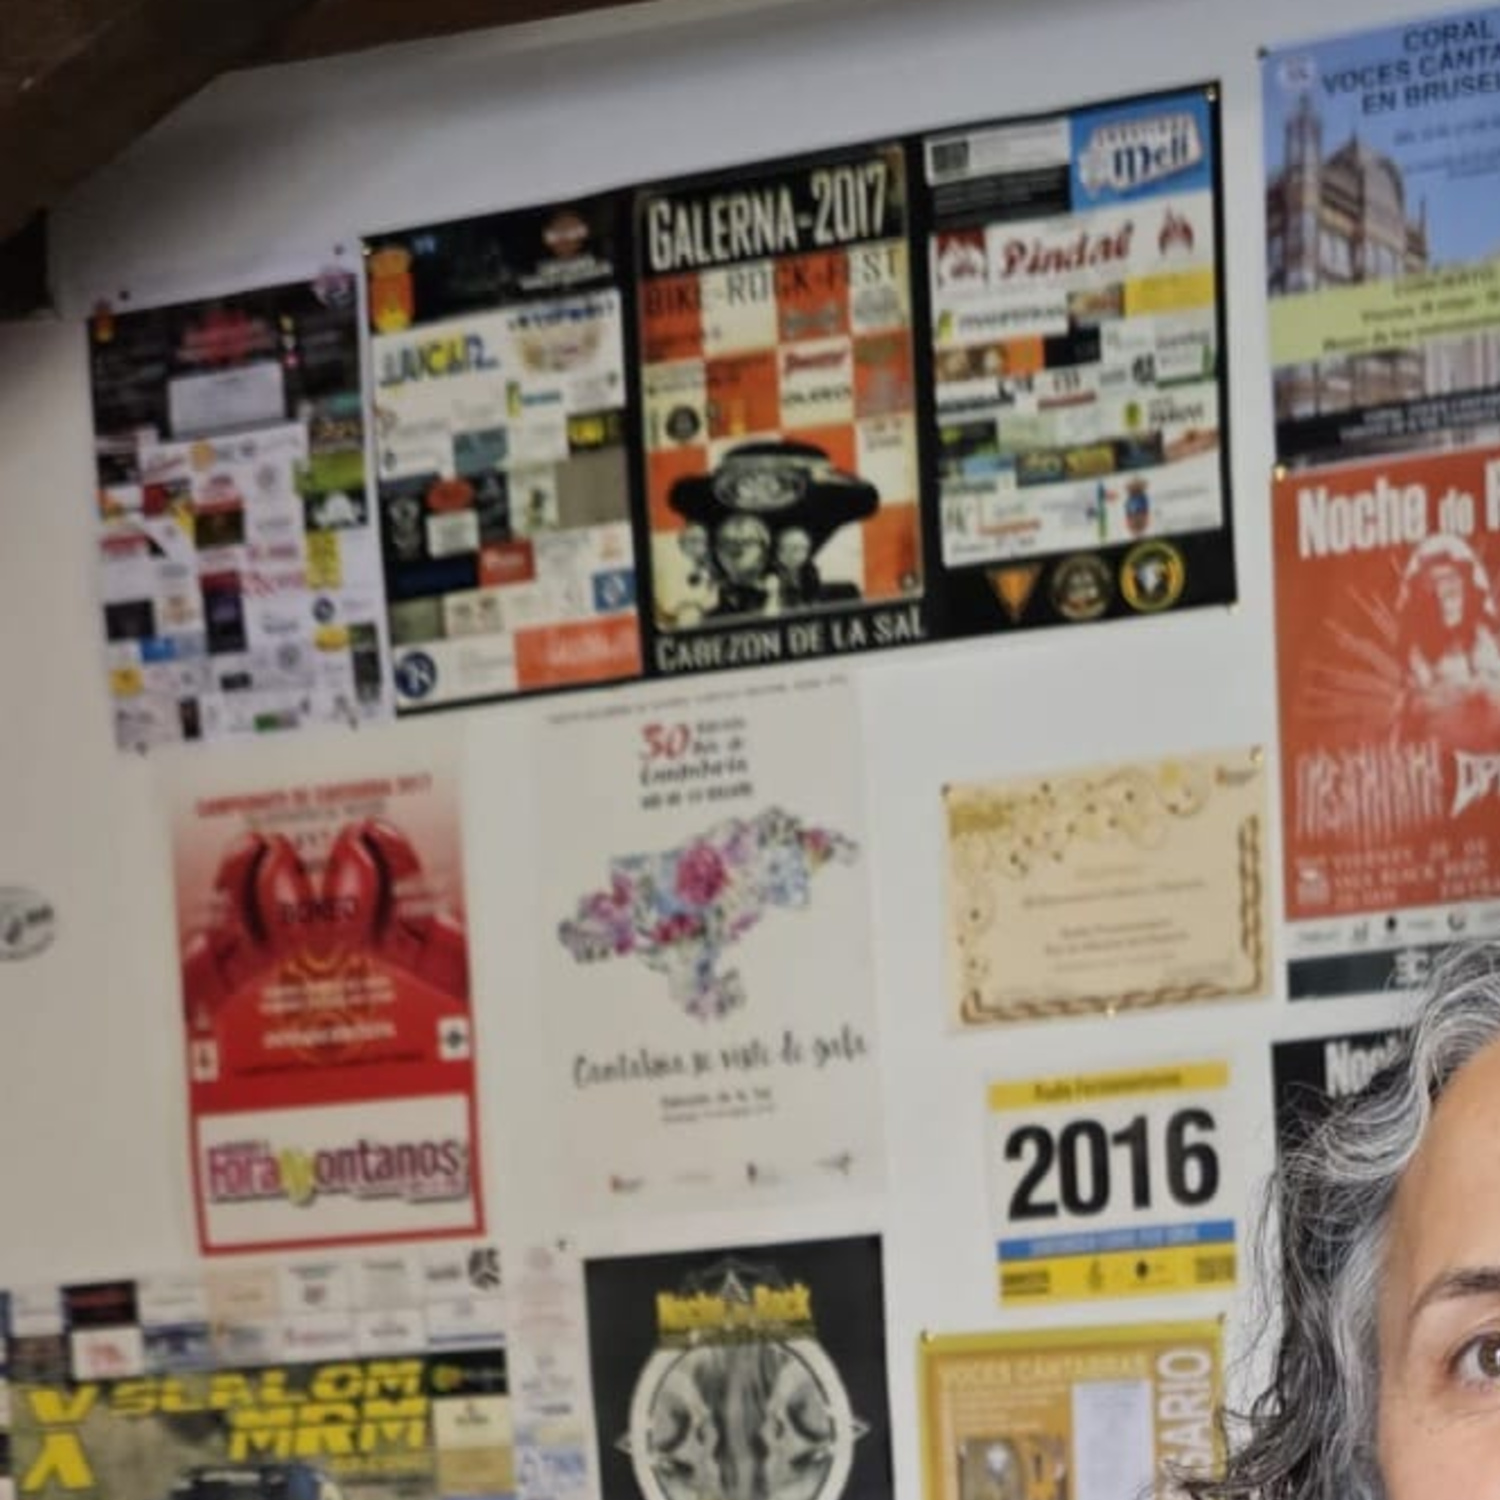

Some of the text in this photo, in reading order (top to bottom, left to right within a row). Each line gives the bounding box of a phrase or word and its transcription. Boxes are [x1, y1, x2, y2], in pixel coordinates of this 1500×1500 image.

[1403, 20, 1494, 52] CORAL
[1321, 59, 1411, 95] VOCES
[1361, 91, 1397, 116] EN
[1298, 475, 1428, 559] Noche
[1438, 488, 1475, 536] de
[789, 622, 822, 655] DE
[831, 619, 867, 650] LA
[873, 604, 924, 645] SAL
[1325, 1036, 1397, 1099] Noc
[1004, 1107, 1221, 1222] 2016
[21, 1358, 424, 1493] X SLALOM
[228, 1398, 428, 1463] MRM
